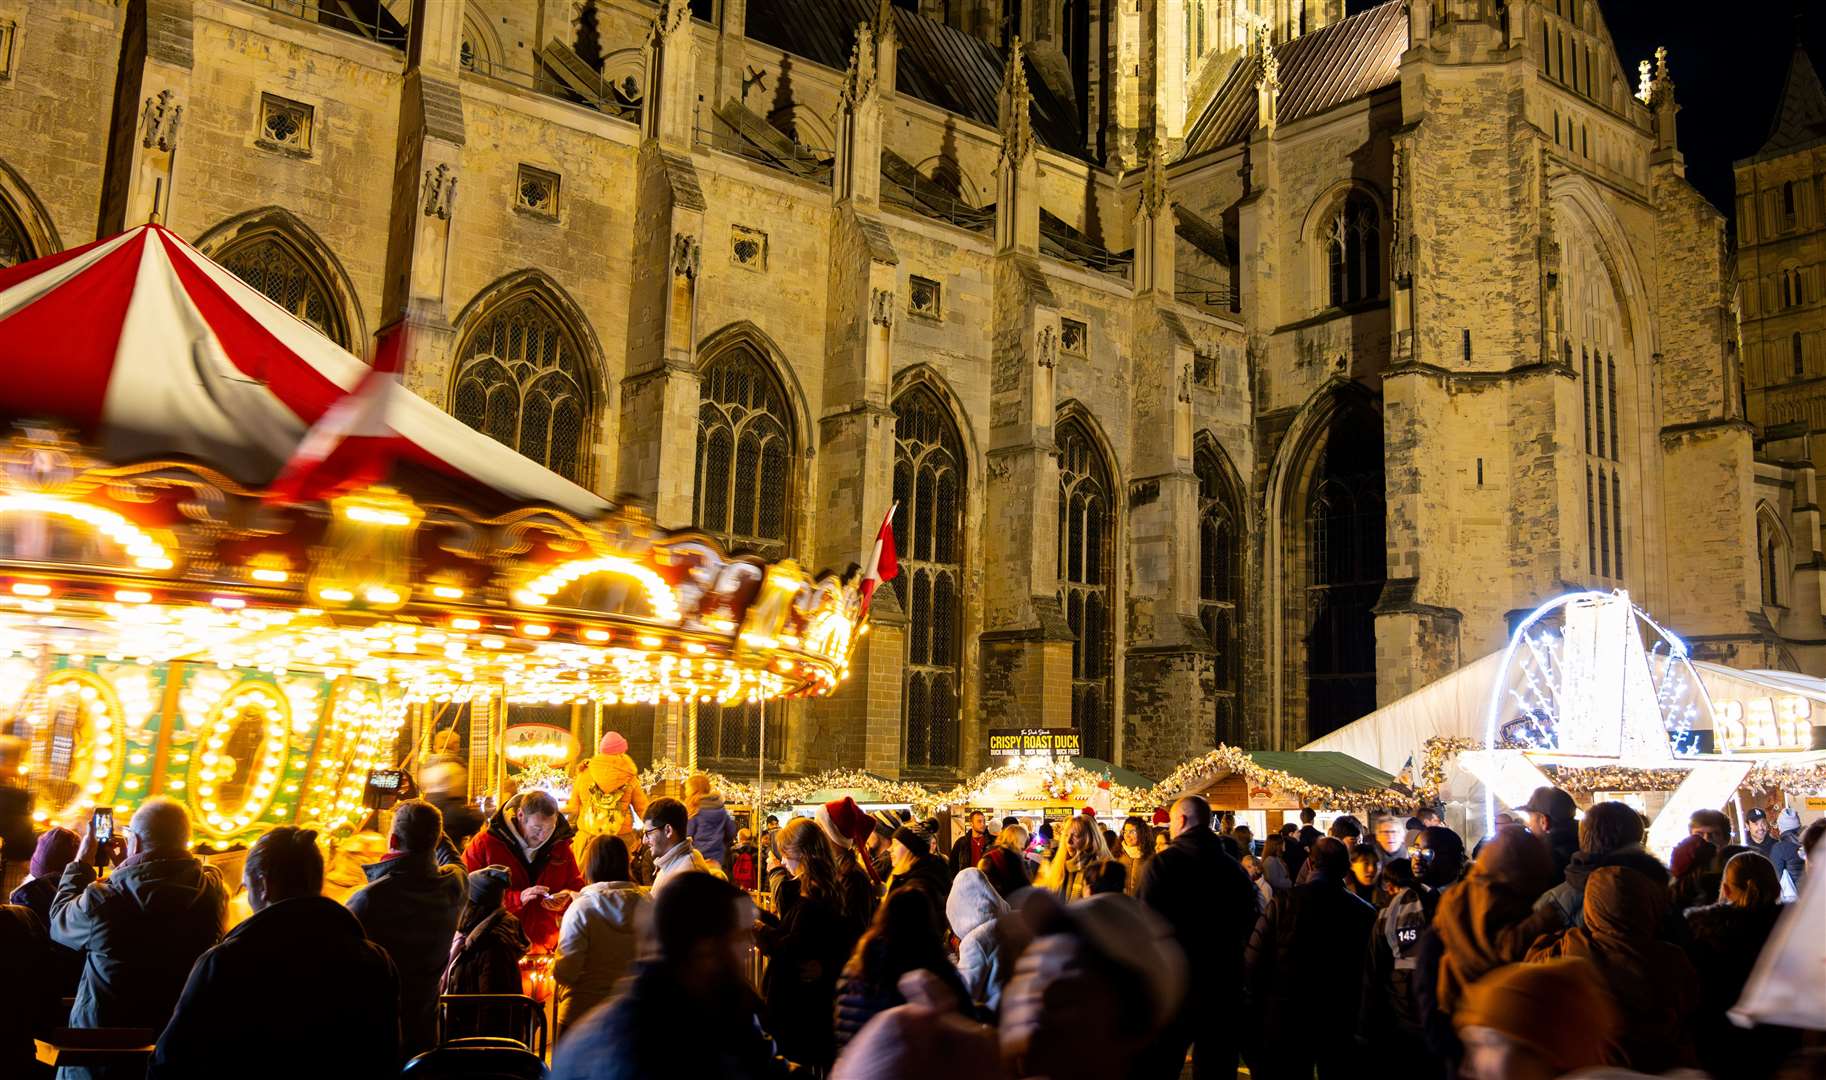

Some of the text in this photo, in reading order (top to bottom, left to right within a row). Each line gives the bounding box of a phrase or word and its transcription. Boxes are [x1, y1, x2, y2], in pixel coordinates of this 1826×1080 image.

[1713, 696, 1813, 748] BAR
[990, 735, 1079, 749] CRISPY ROAST DUCK
[1398, 929, 1417, 942] 145
